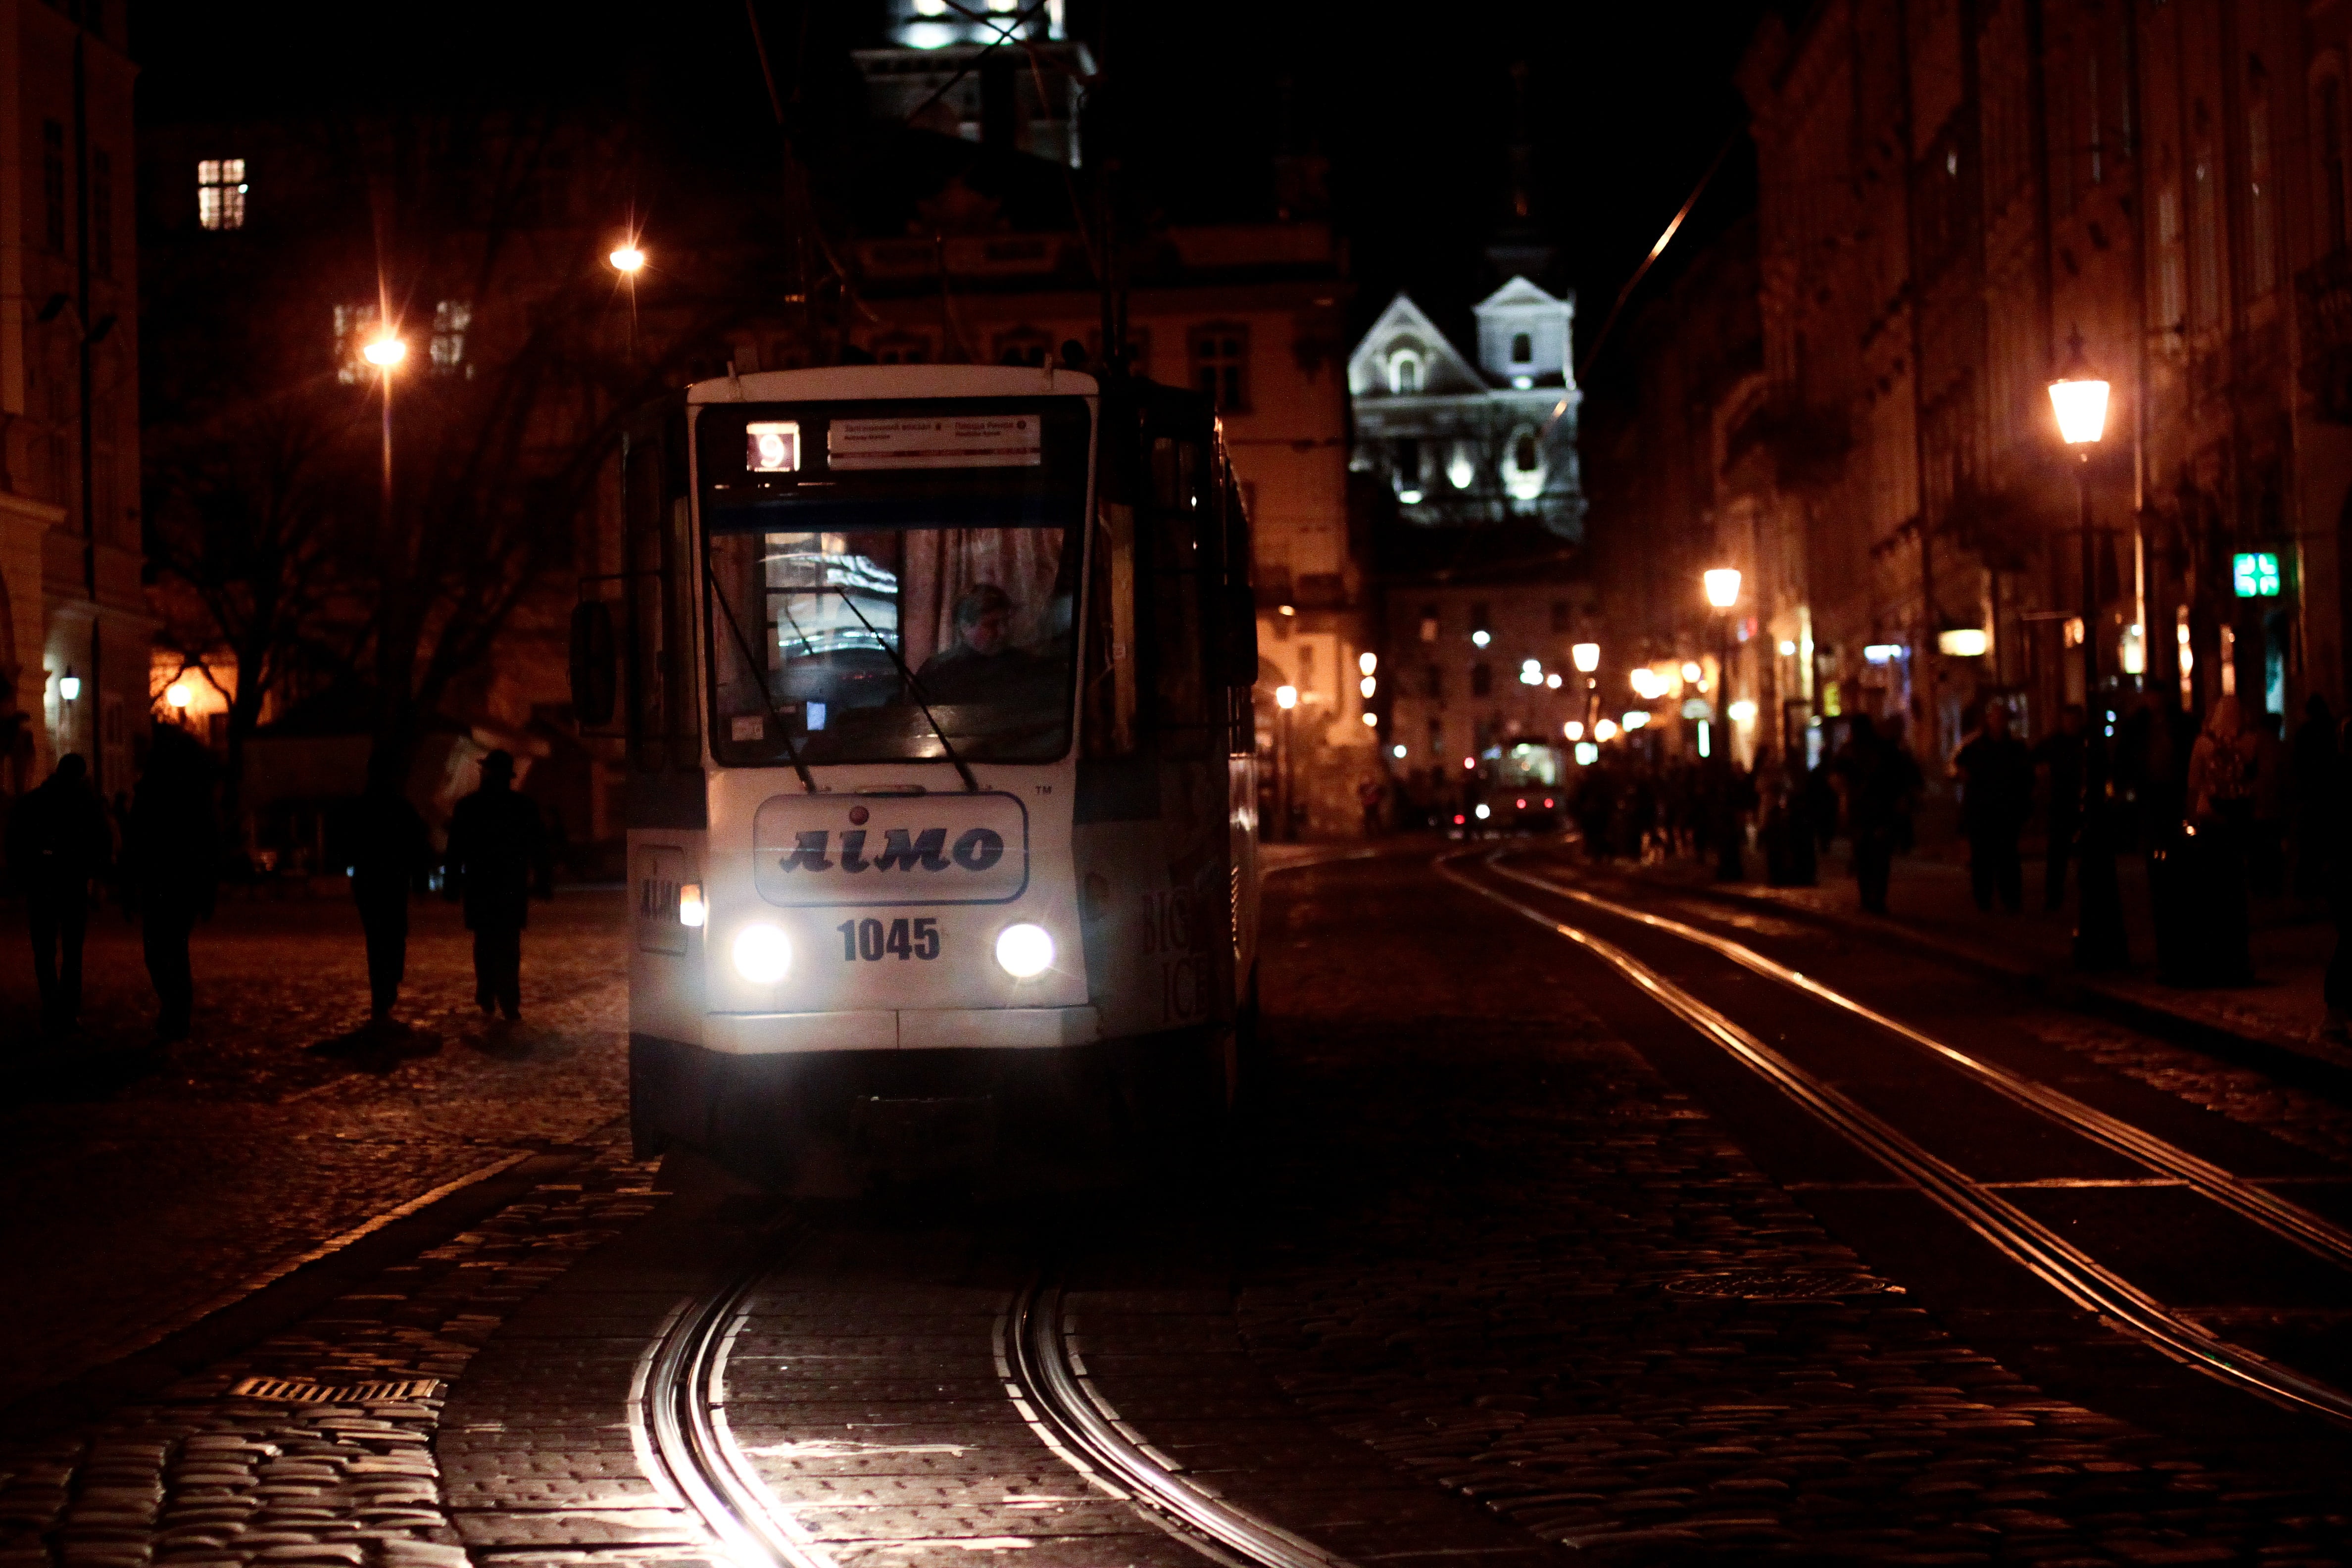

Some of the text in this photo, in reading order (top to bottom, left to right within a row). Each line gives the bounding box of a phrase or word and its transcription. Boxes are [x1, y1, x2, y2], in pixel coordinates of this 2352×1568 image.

[759, 433, 784, 468] 9
[1035, 785, 1052, 794] TM
[837, 918, 940, 961] 1045
